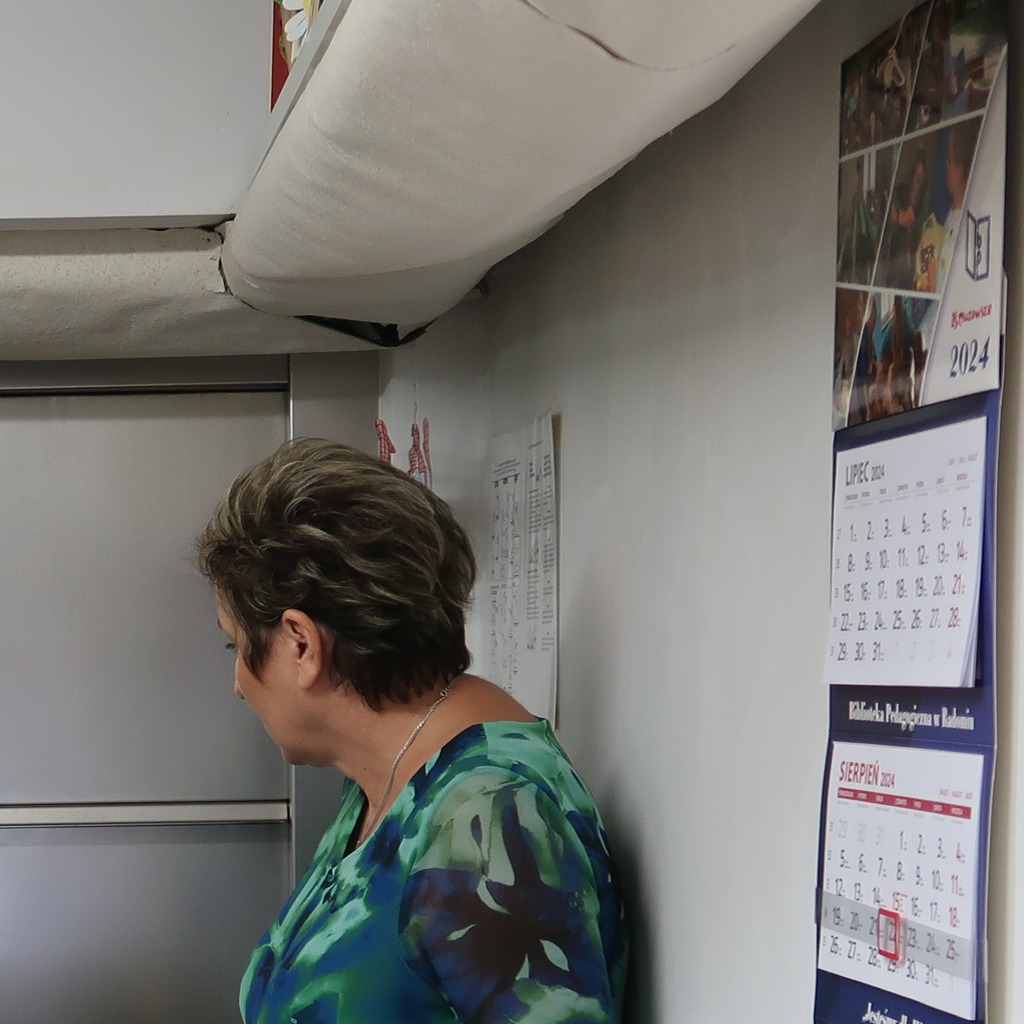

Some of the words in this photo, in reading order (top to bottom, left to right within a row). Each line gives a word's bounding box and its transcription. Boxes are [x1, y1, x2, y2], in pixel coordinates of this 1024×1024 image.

[950, 335, 990, 377] 2024
[846, 460, 869, 486] LIPIEC
[871, 464, 885, 482] 2024
[849, 700, 884, 722] Biblioteka
[886, 703, 932, 731] Pedagogiczna
[934, 714, 940, 727] w
[942, 707, 974, 730] Radomiu
[839, 760, 879, 785] SIERPIEŃ
[880, 772, 895, 788] 2024
